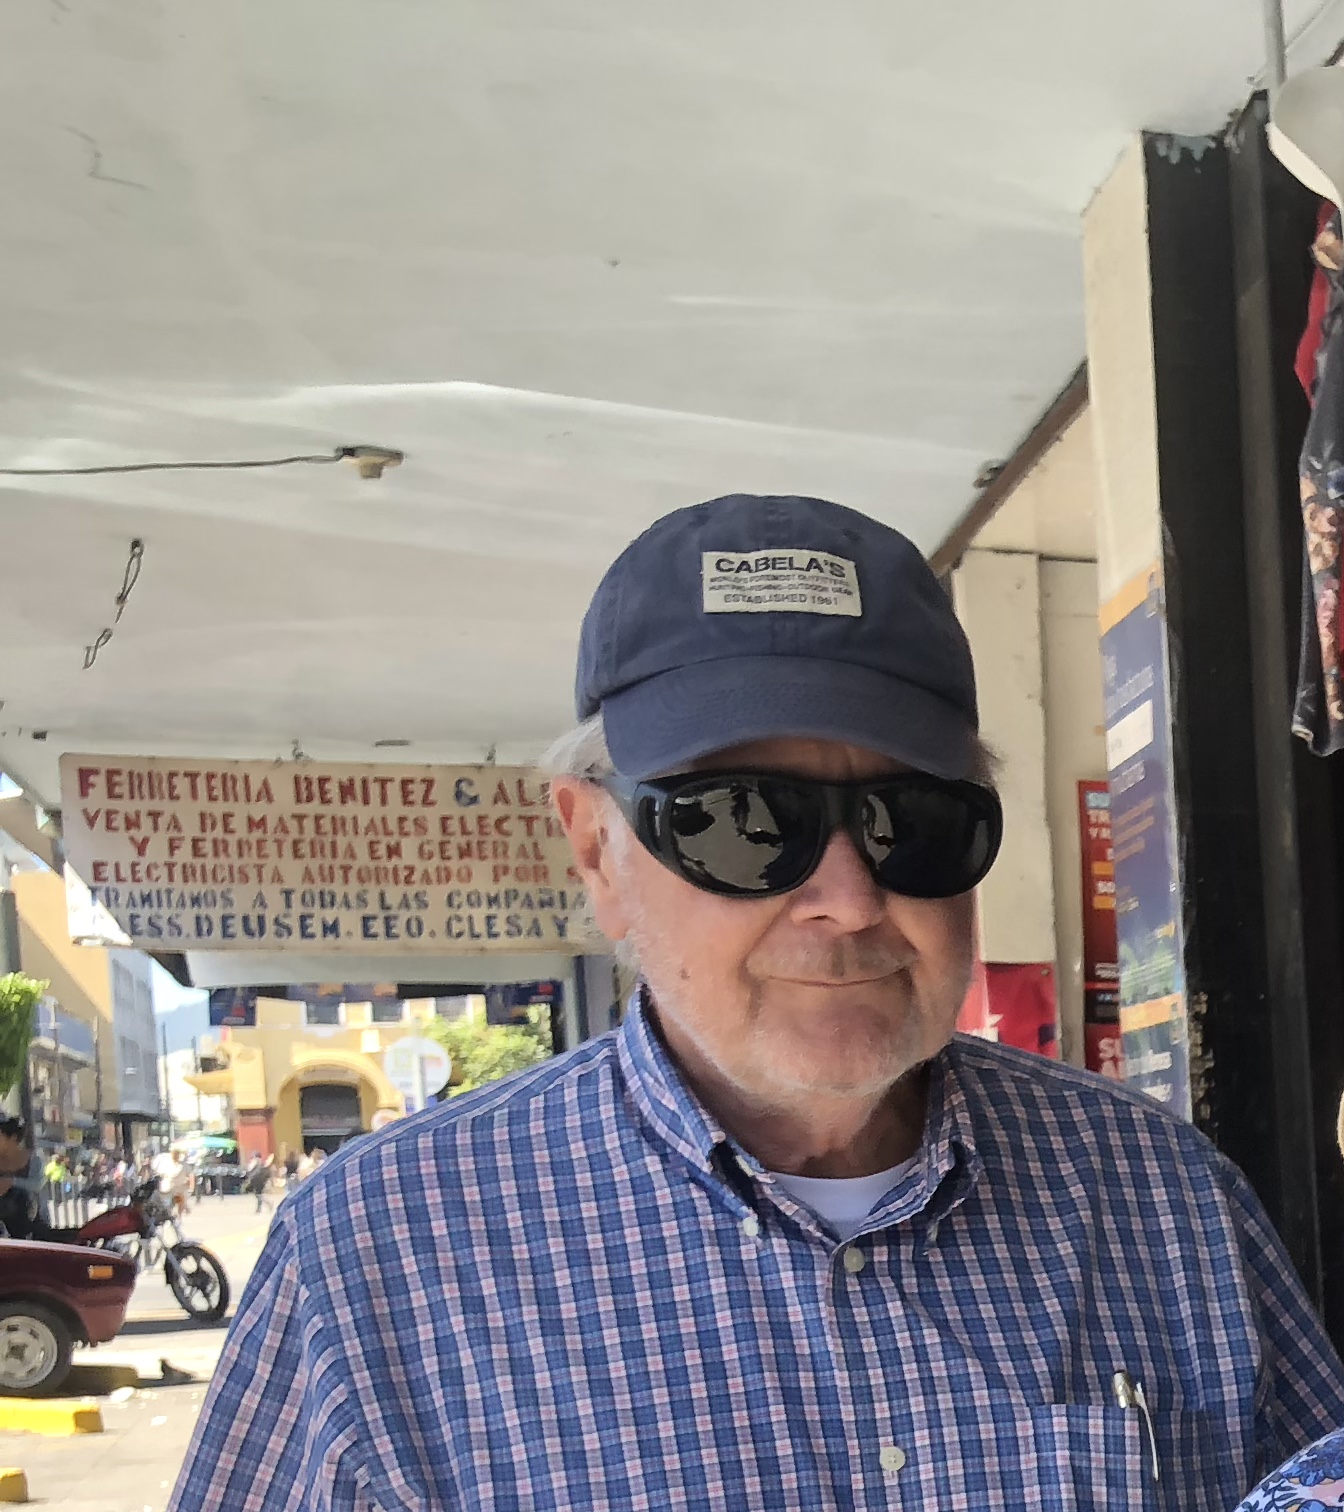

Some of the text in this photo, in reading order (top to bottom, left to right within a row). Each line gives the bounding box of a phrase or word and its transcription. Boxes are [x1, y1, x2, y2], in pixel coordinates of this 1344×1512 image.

[714, 556, 847, 579] CABELA'S
[724, 593, 808, 604] ESTABLISHED
[77, 766, 275, 804] FERRETERIA
[294, 773, 437, 807] BENITEZ
[82, 807, 183, 834] VENTA
[200, 812, 236, 834] DE
[248, 812, 429, 837] MATERIALES
[129, 835, 545, 862] Y FERRETERIA EN GENERAL
[91, 860, 285, 885] ELECTRICISTA
[301, 864, 473, 886] AUTORIZADO
[491, 864, 552, 884] POR
[89, 885, 235, 911] TRAMITAMOS
[252, 889, 268, 910] A
[280, 888, 369, 910] TODAS
[378, 889, 430, 911] LAS
